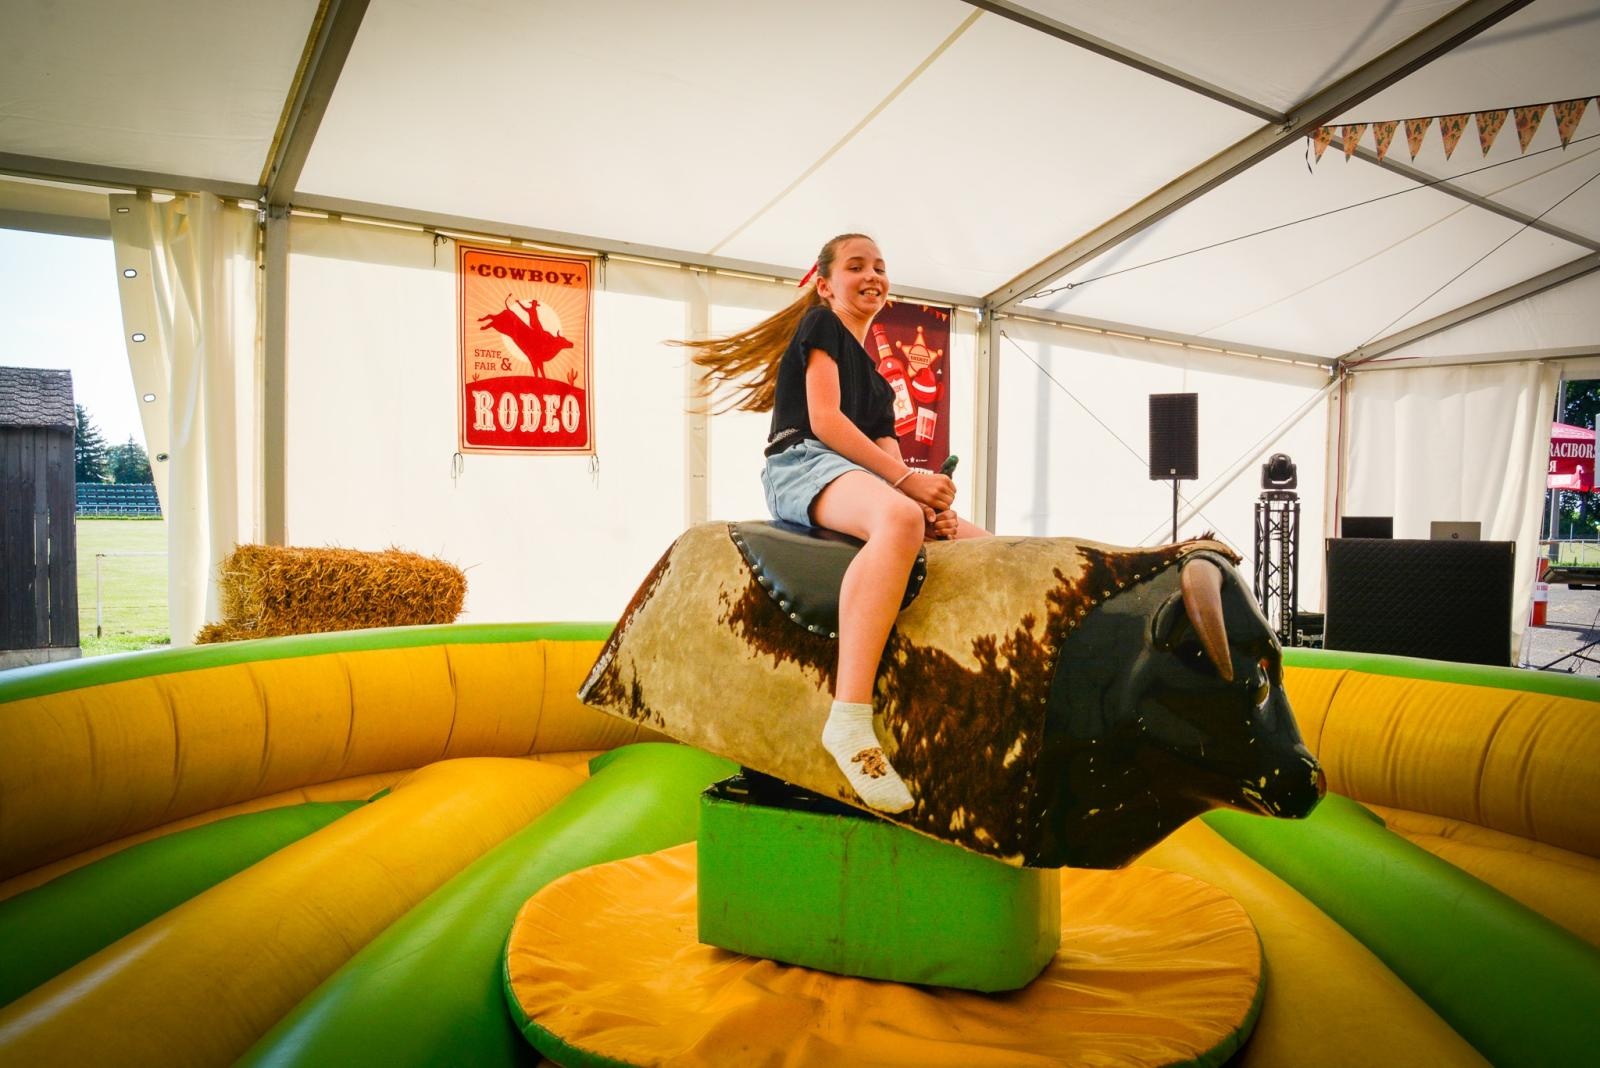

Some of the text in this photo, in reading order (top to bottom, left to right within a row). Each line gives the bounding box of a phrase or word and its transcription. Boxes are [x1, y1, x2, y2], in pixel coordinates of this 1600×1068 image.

[477, 263, 577, 285] COWBOY
[474, 348, 502, 359] STATE
[474, 357, 513, 371] FAIR &
[472, 390, 581, 433] RODEO
[1549, 442, 1596, 459] RACIBOR
